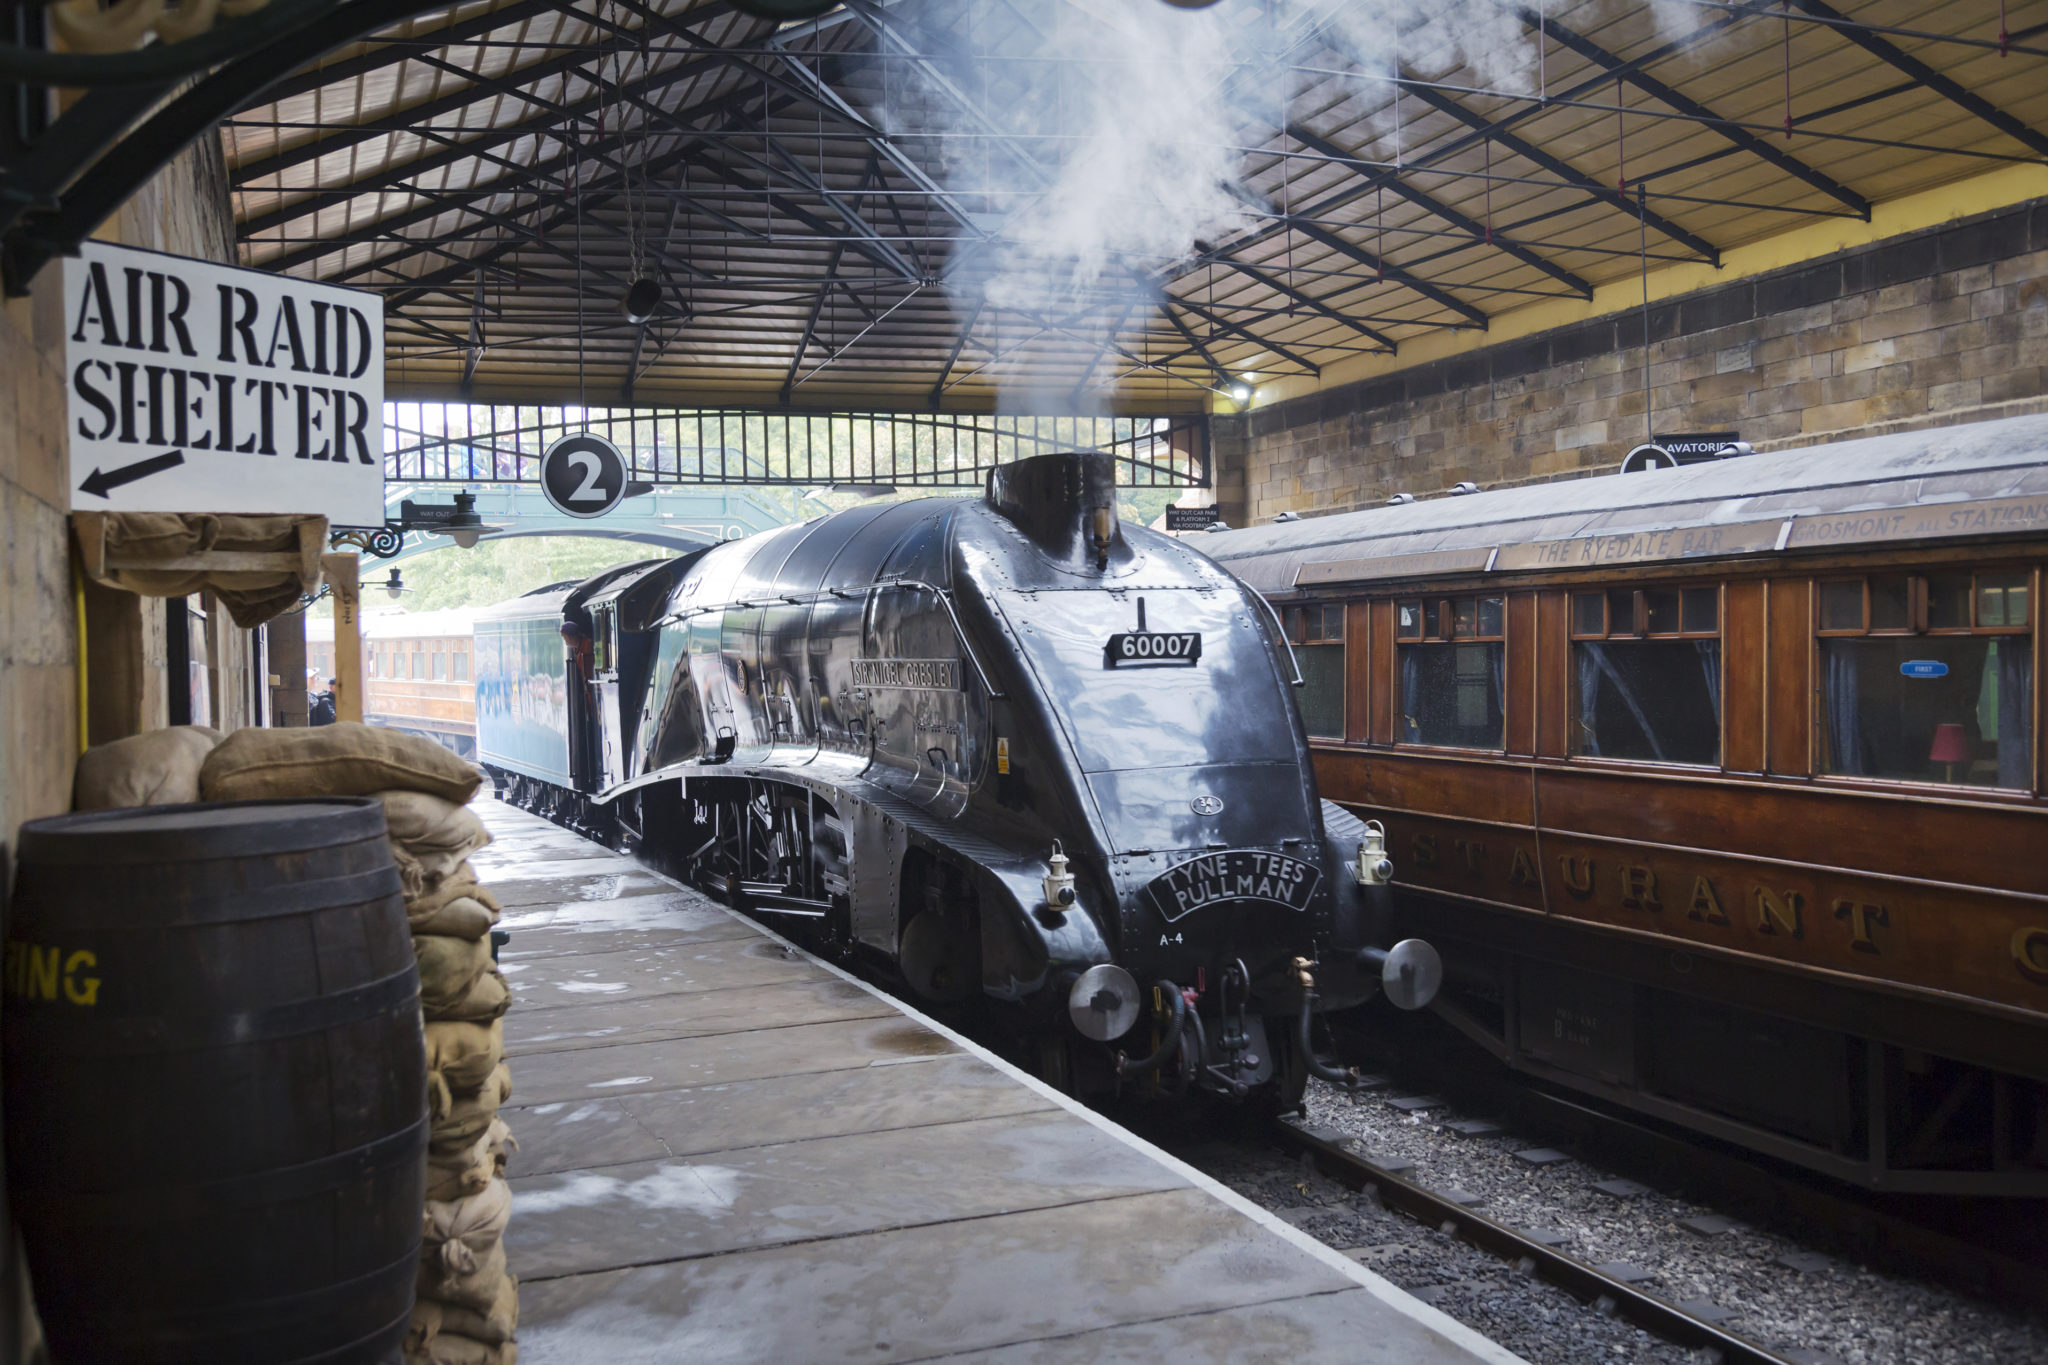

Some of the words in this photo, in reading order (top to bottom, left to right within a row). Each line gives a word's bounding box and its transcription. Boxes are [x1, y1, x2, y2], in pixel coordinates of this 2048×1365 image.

[71, 261, 198, 357] AIR
[216, 283, 372, 379] RAID
[73, 359, 375, 465] SHELTER
[567, 450, 607, 501] 2
[1537, 543, 1571, 563] THE
[1581, 532, 1673, 561] RYEDALE
[1682, 529, 1723, 552] BAR
[1793, 515, 1906, 541] GROSMONT
[1915, 518, 1940, 532] ALL
[1122, 635, 1195, 656] 60007
[854, 663, 871, 684] SIR
[872, 663, 903, 685] NIGEL
[907, 663, 953, 687] GRESLEY
[1175, 875, 1294, 911] PULLMAN
[1411, 833, 1889, 953] STAURANT
[1159, 932, 1184, 946] A-4
[12, 943, 101, 1006] ING
